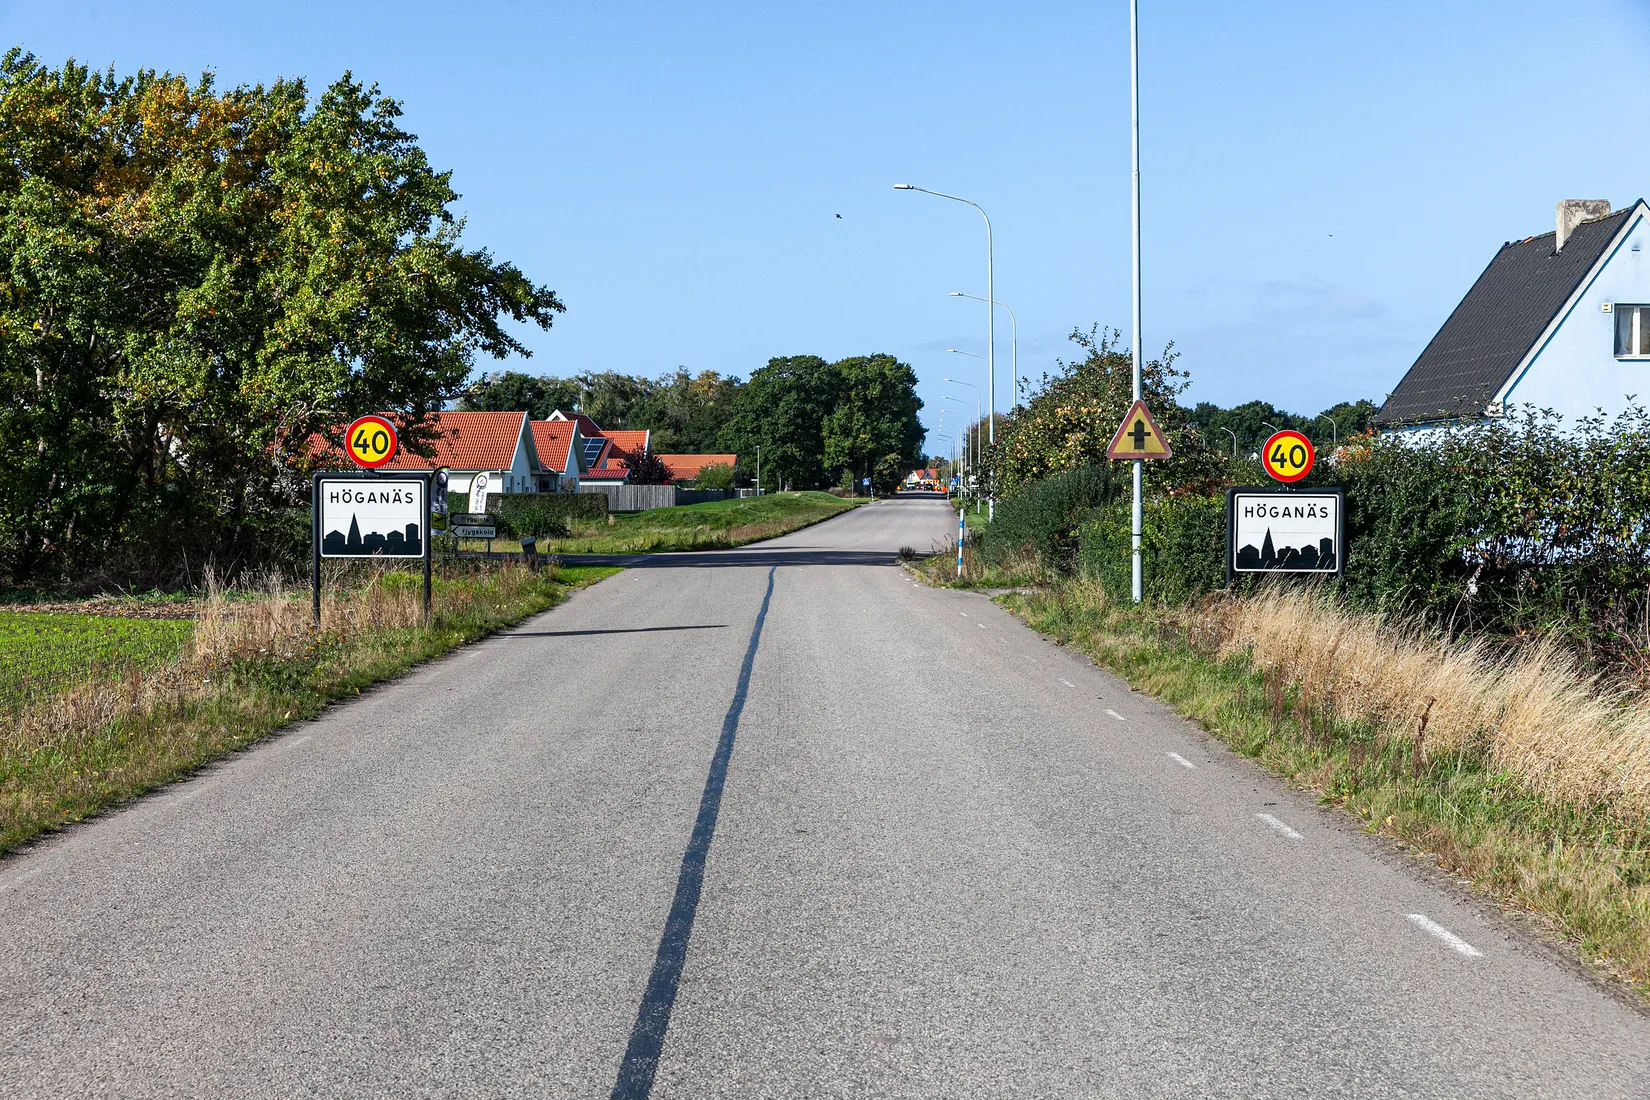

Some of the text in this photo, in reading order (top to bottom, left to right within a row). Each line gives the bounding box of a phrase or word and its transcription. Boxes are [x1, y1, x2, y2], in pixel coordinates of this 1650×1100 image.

[353, 429, 389, 455] 40
[1270, 444, 1307, 469] 40
[330, 488, 414, 504] HÖGANÄS
[1244, 503, 1329, 519] HÖGANÄS
[462, 528, 494, 536] Flygskola
